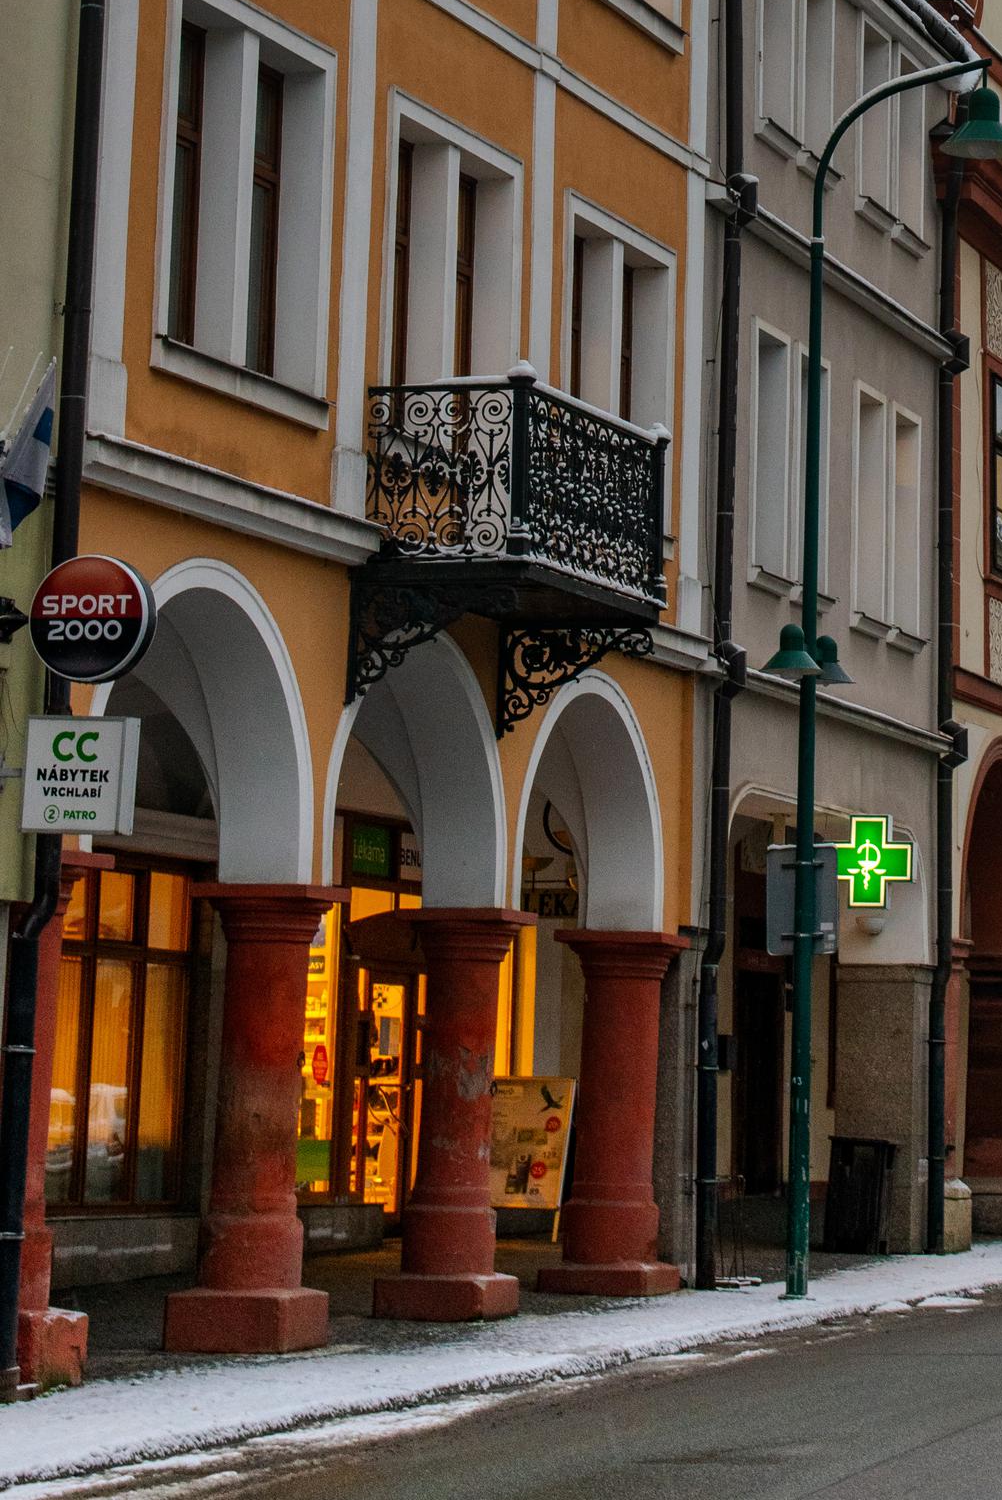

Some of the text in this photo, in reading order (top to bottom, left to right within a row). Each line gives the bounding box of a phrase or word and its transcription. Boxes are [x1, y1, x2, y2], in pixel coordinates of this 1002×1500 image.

[42, 594, 133, 615] SPORT
[47, 620, 122, 640] 2000
[52, 731, 100, 763] CC
[36, 764, 110, 783] NÁBYTEK
[43, 785, 102, 798] VRCHLABÍ
[48, 809, 97, 820] 2 PATRO
